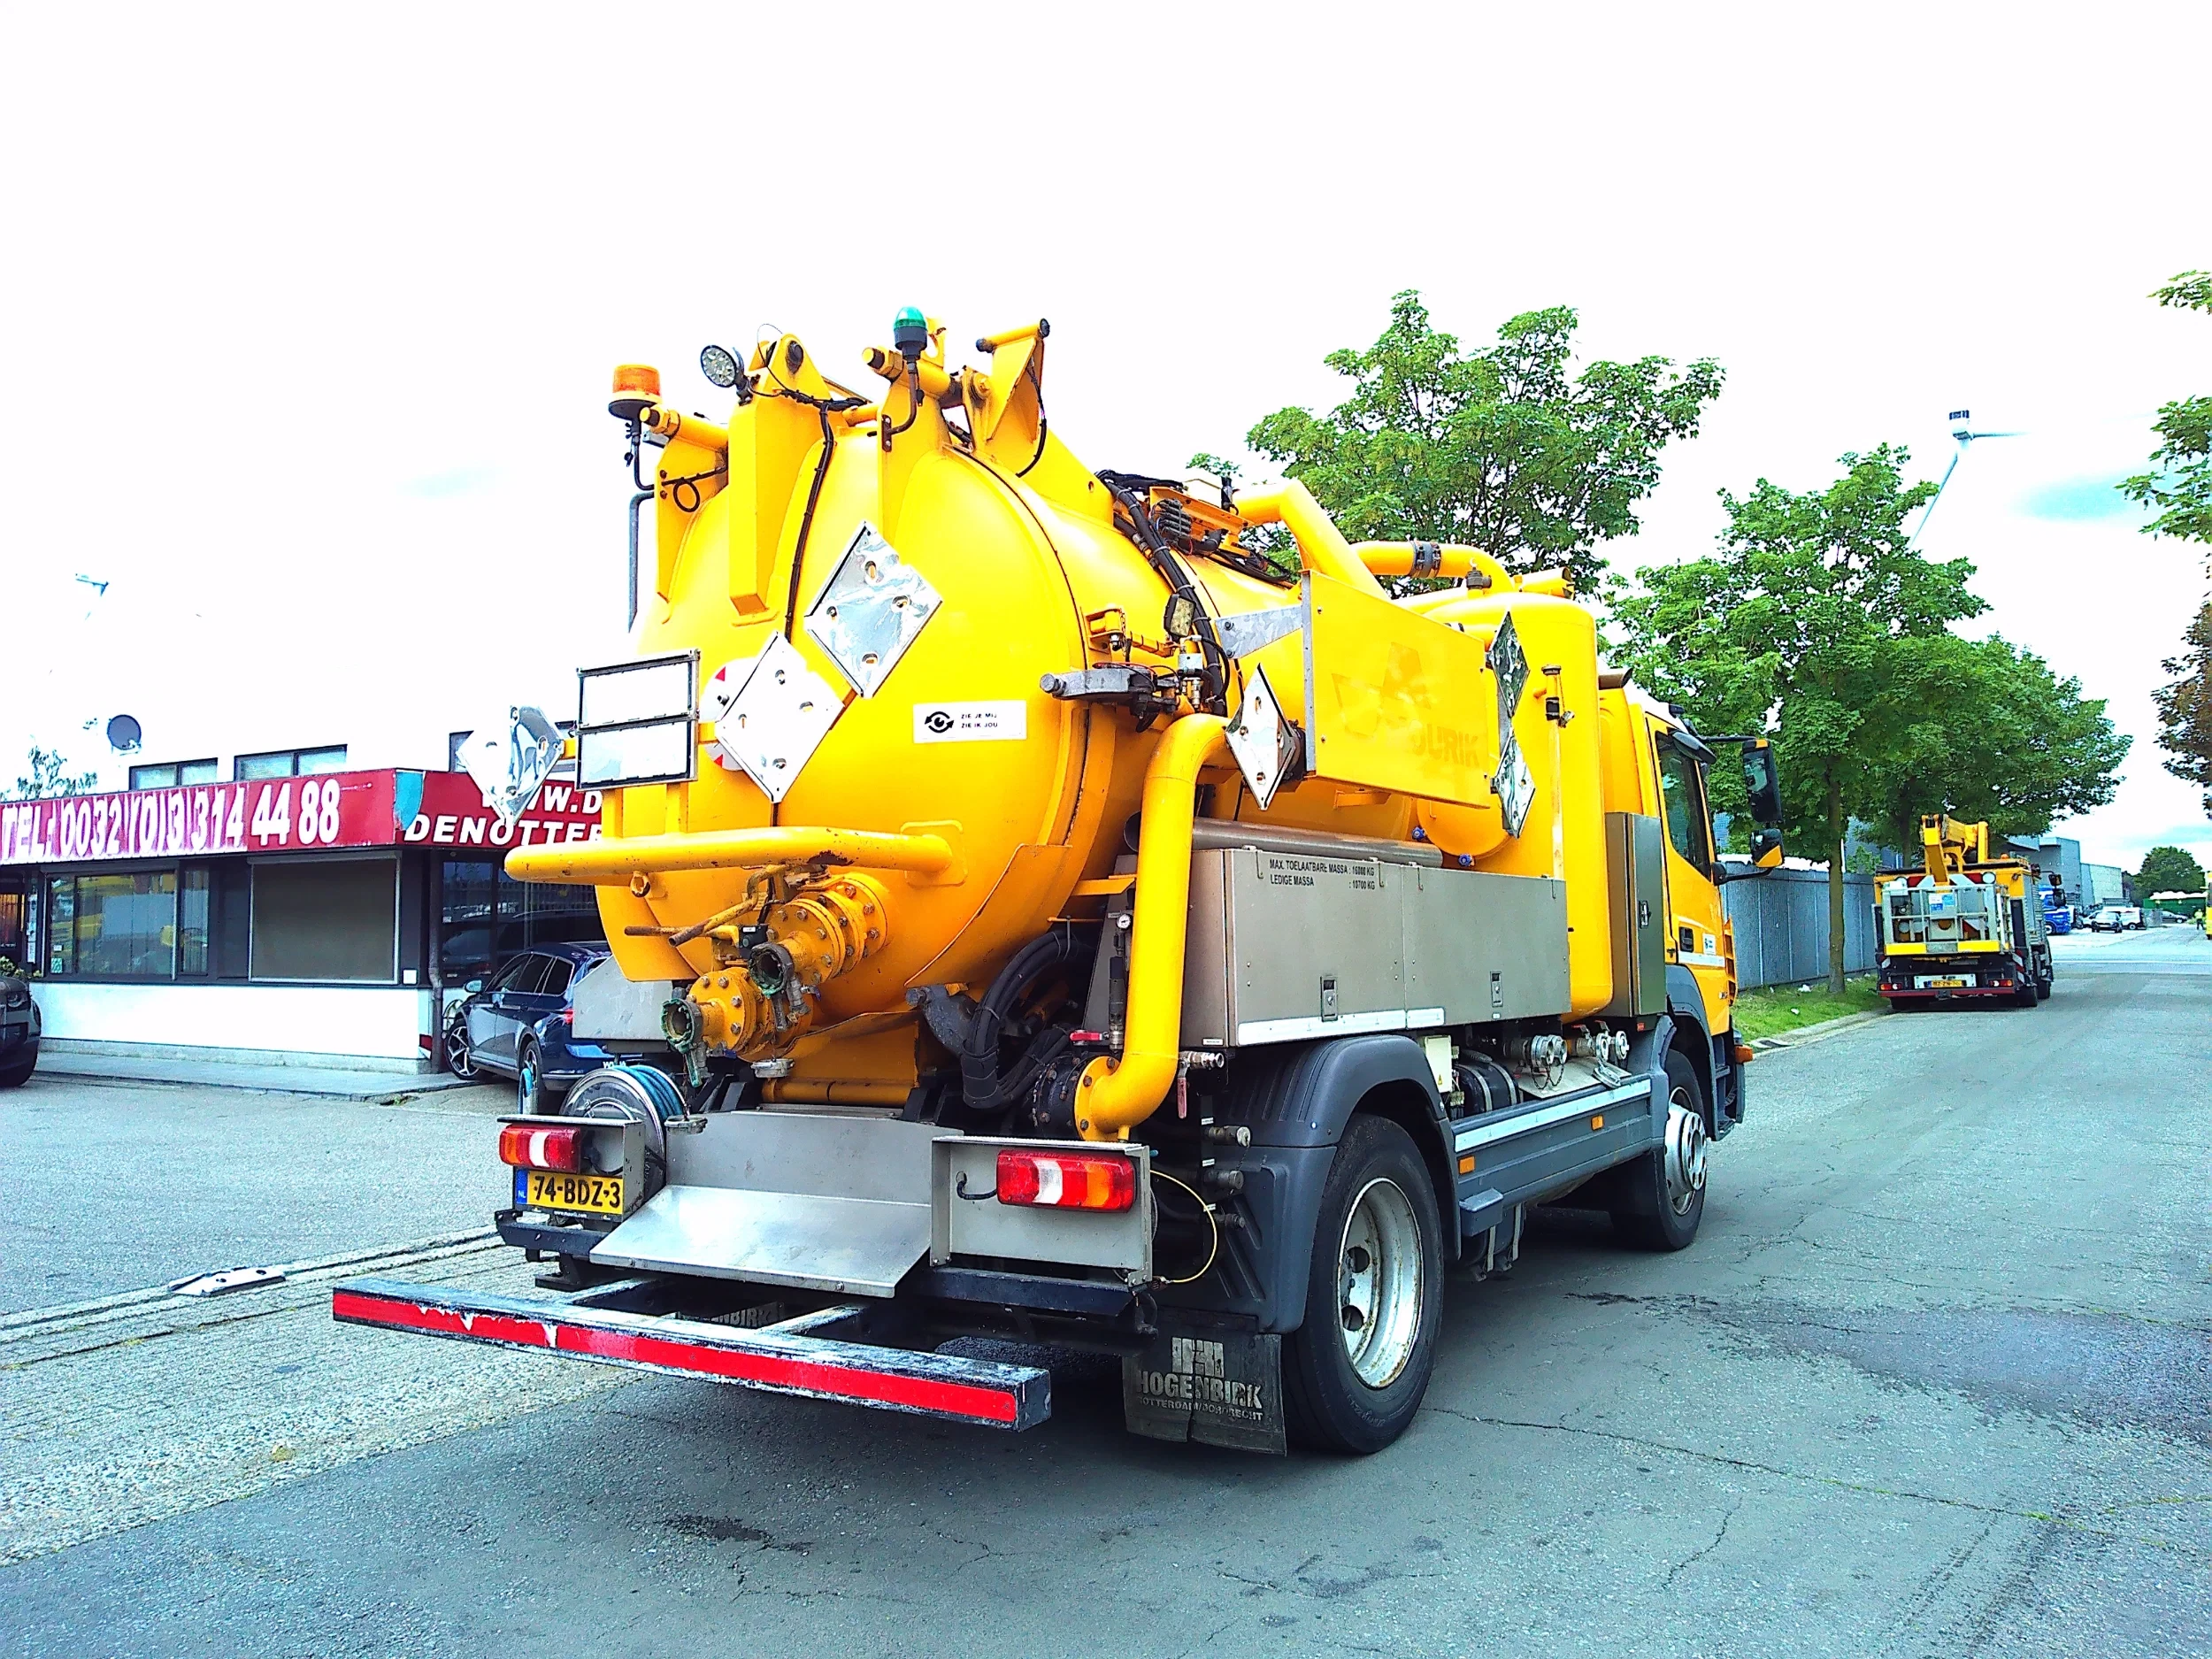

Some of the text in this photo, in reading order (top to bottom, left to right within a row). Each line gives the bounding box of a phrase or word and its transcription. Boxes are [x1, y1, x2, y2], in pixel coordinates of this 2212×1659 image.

[251, 782, 291, 847] 44
[298, 779, 342, 845] 88
[1270, 874, 1292, 886] LEDIGE
[1293, 877, 1314, 887] MASSA
[1367, 880, 1375, 890] KG
[1328, 864, 1348, 874] MASSA
[1366, 867, 1374, 876] KG
[1138, 1371, 1263, 1409] HOGENBIRK
[1139, 1396, 1263, 1421] OTTERDAM/DORDRECHT
